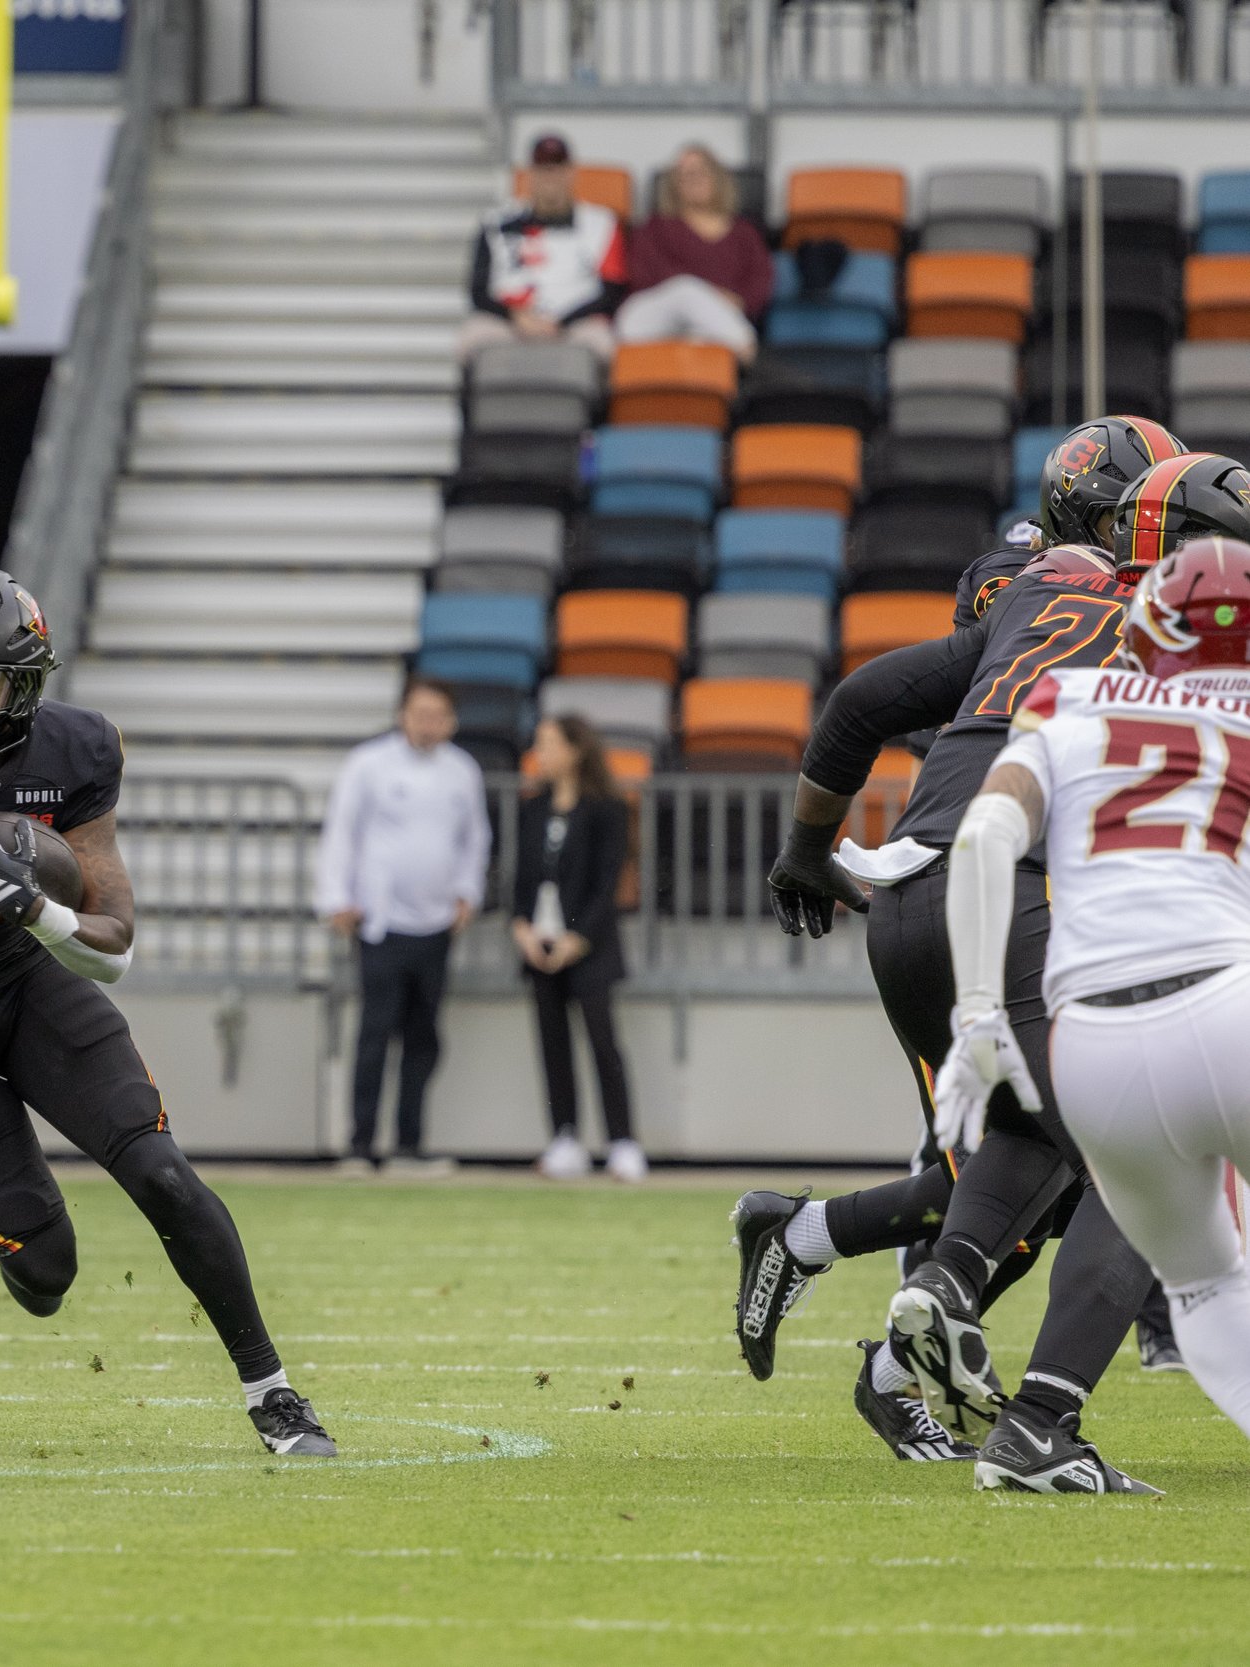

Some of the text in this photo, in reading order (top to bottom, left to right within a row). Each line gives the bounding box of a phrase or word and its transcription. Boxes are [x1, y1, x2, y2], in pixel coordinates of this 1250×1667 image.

[974, 594, 1127, 715] 7
[15, 789, 64, 804] NOBULL
[1061, 1469, 1095, 1489] ALPHA
